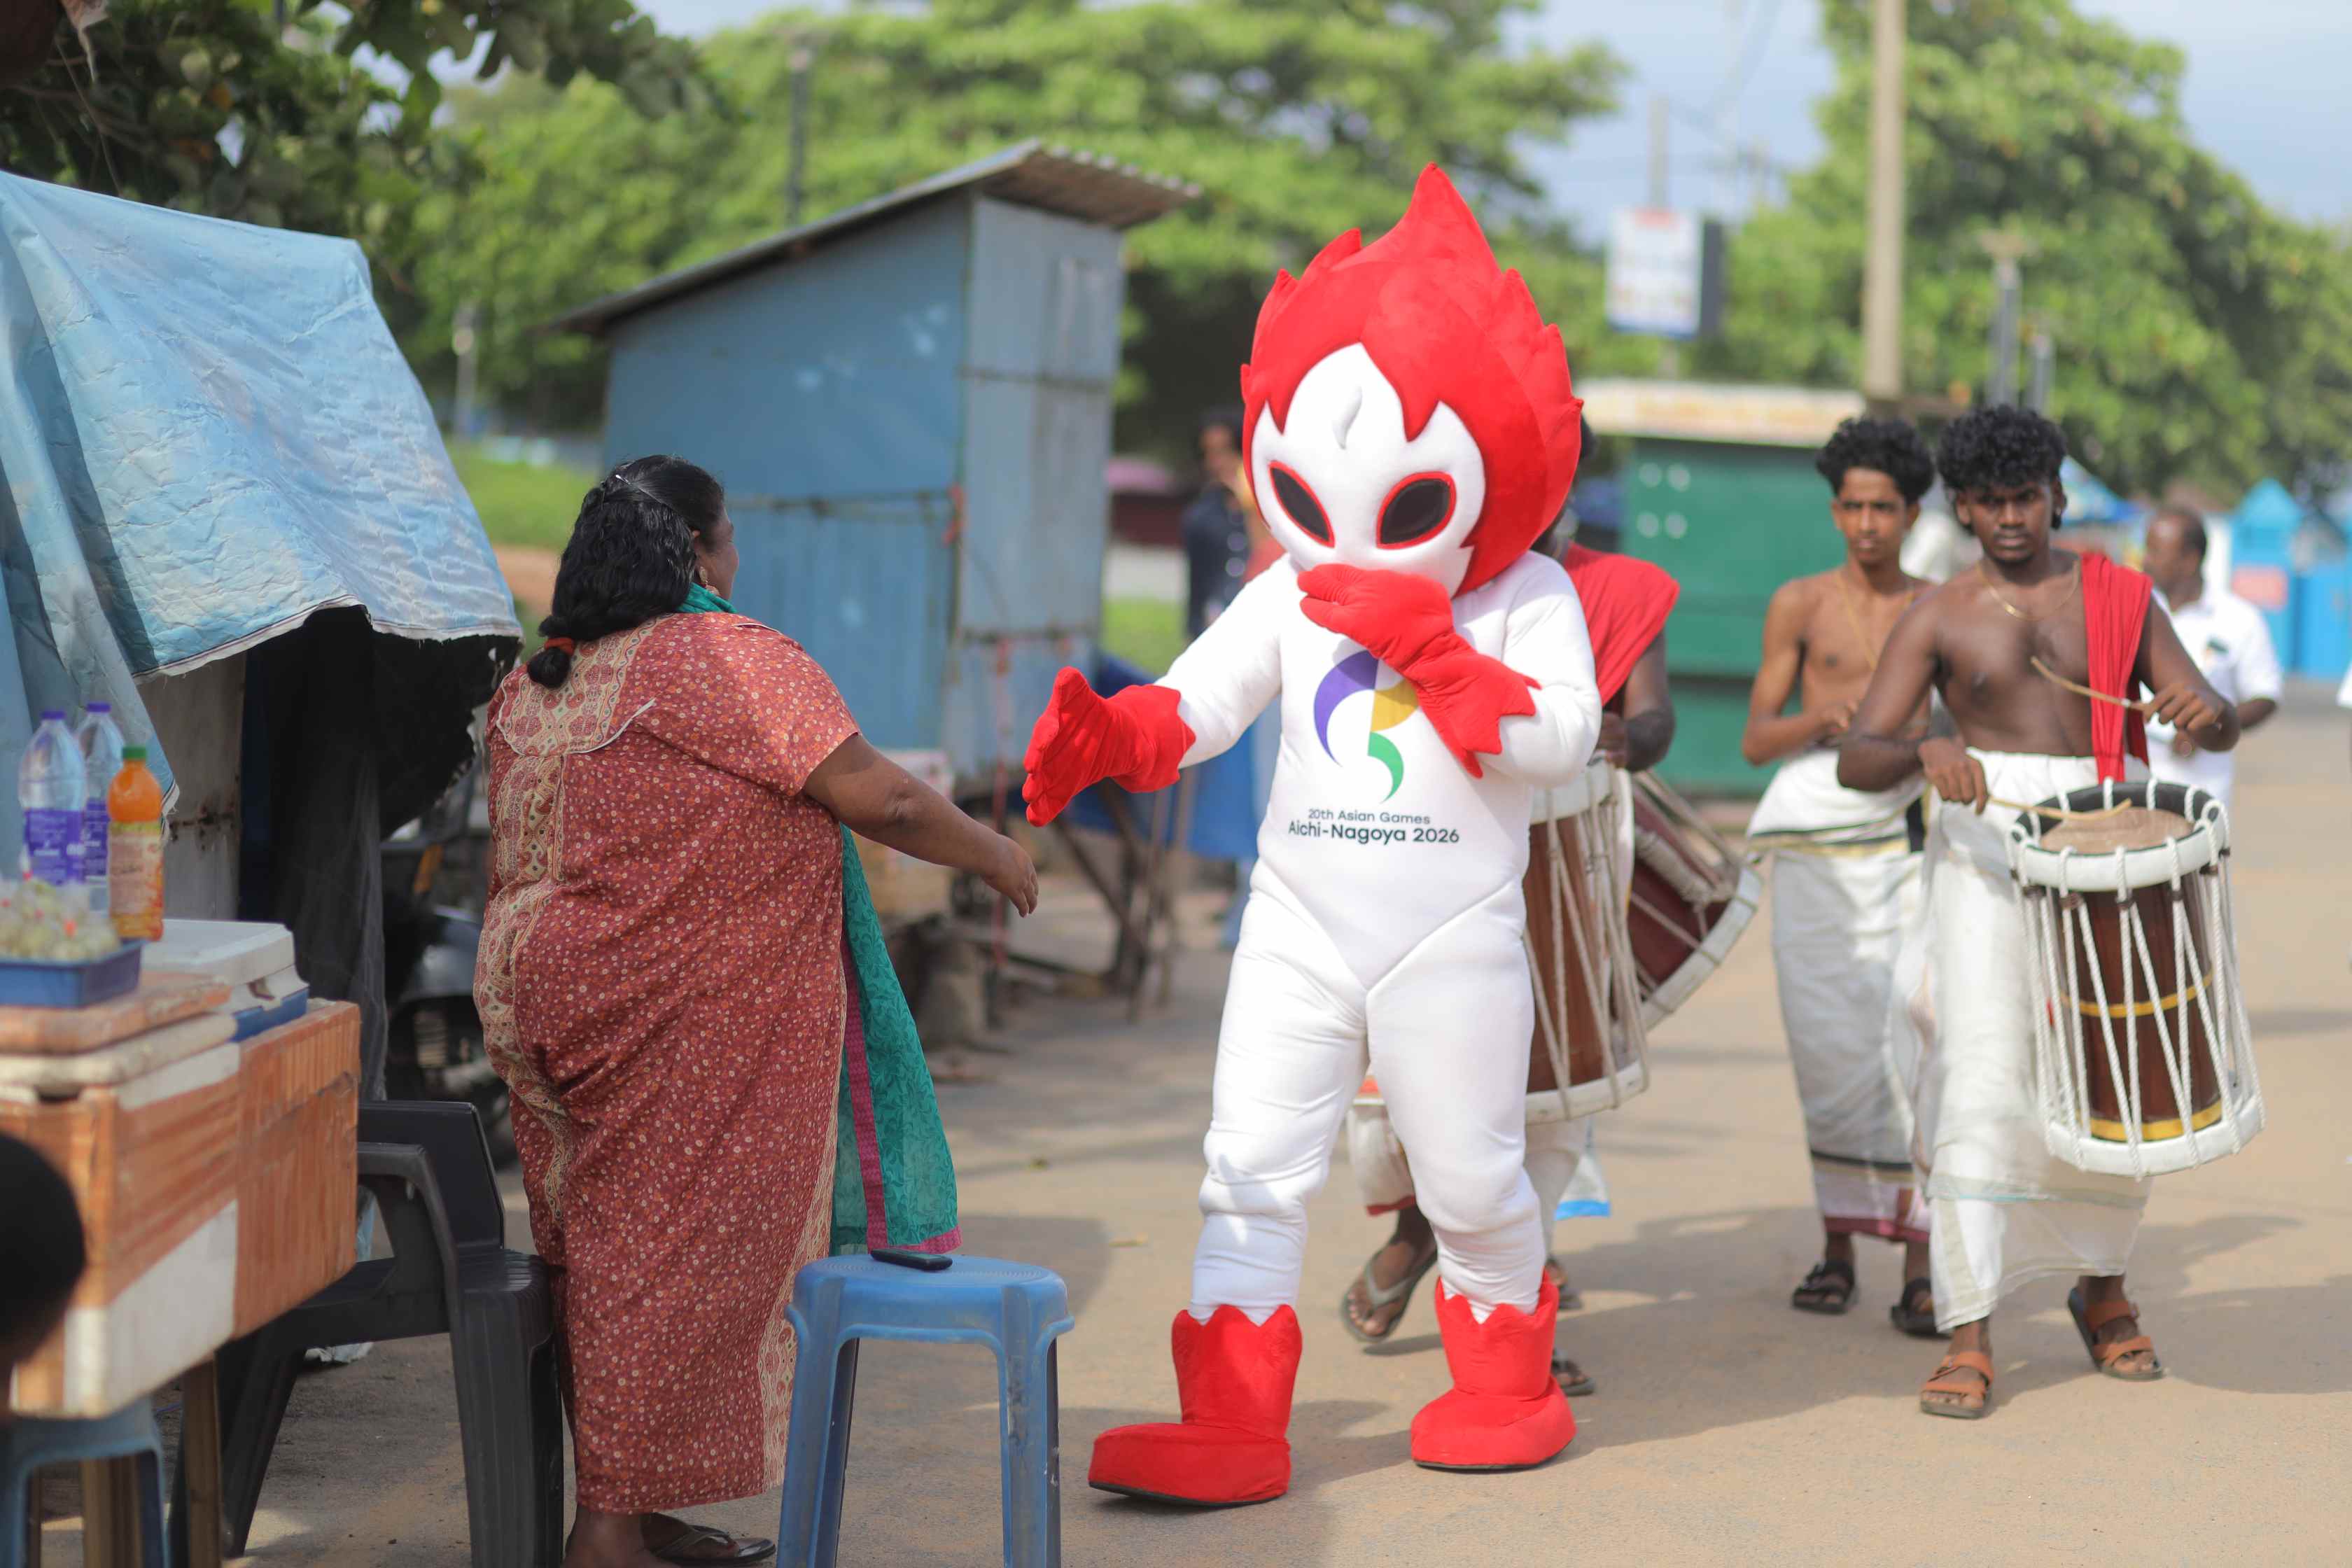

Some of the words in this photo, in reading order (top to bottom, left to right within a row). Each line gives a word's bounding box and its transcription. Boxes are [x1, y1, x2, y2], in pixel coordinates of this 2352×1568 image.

[1308, 808, 1334, 820] 20th
[1338, 810, 1376, 822] Asian
[1379, 811, 1431, 825] Games
[1288, 821, 1406, 845] Aichi-Nagoya
[1413, 828, 1460, 844] 2026
